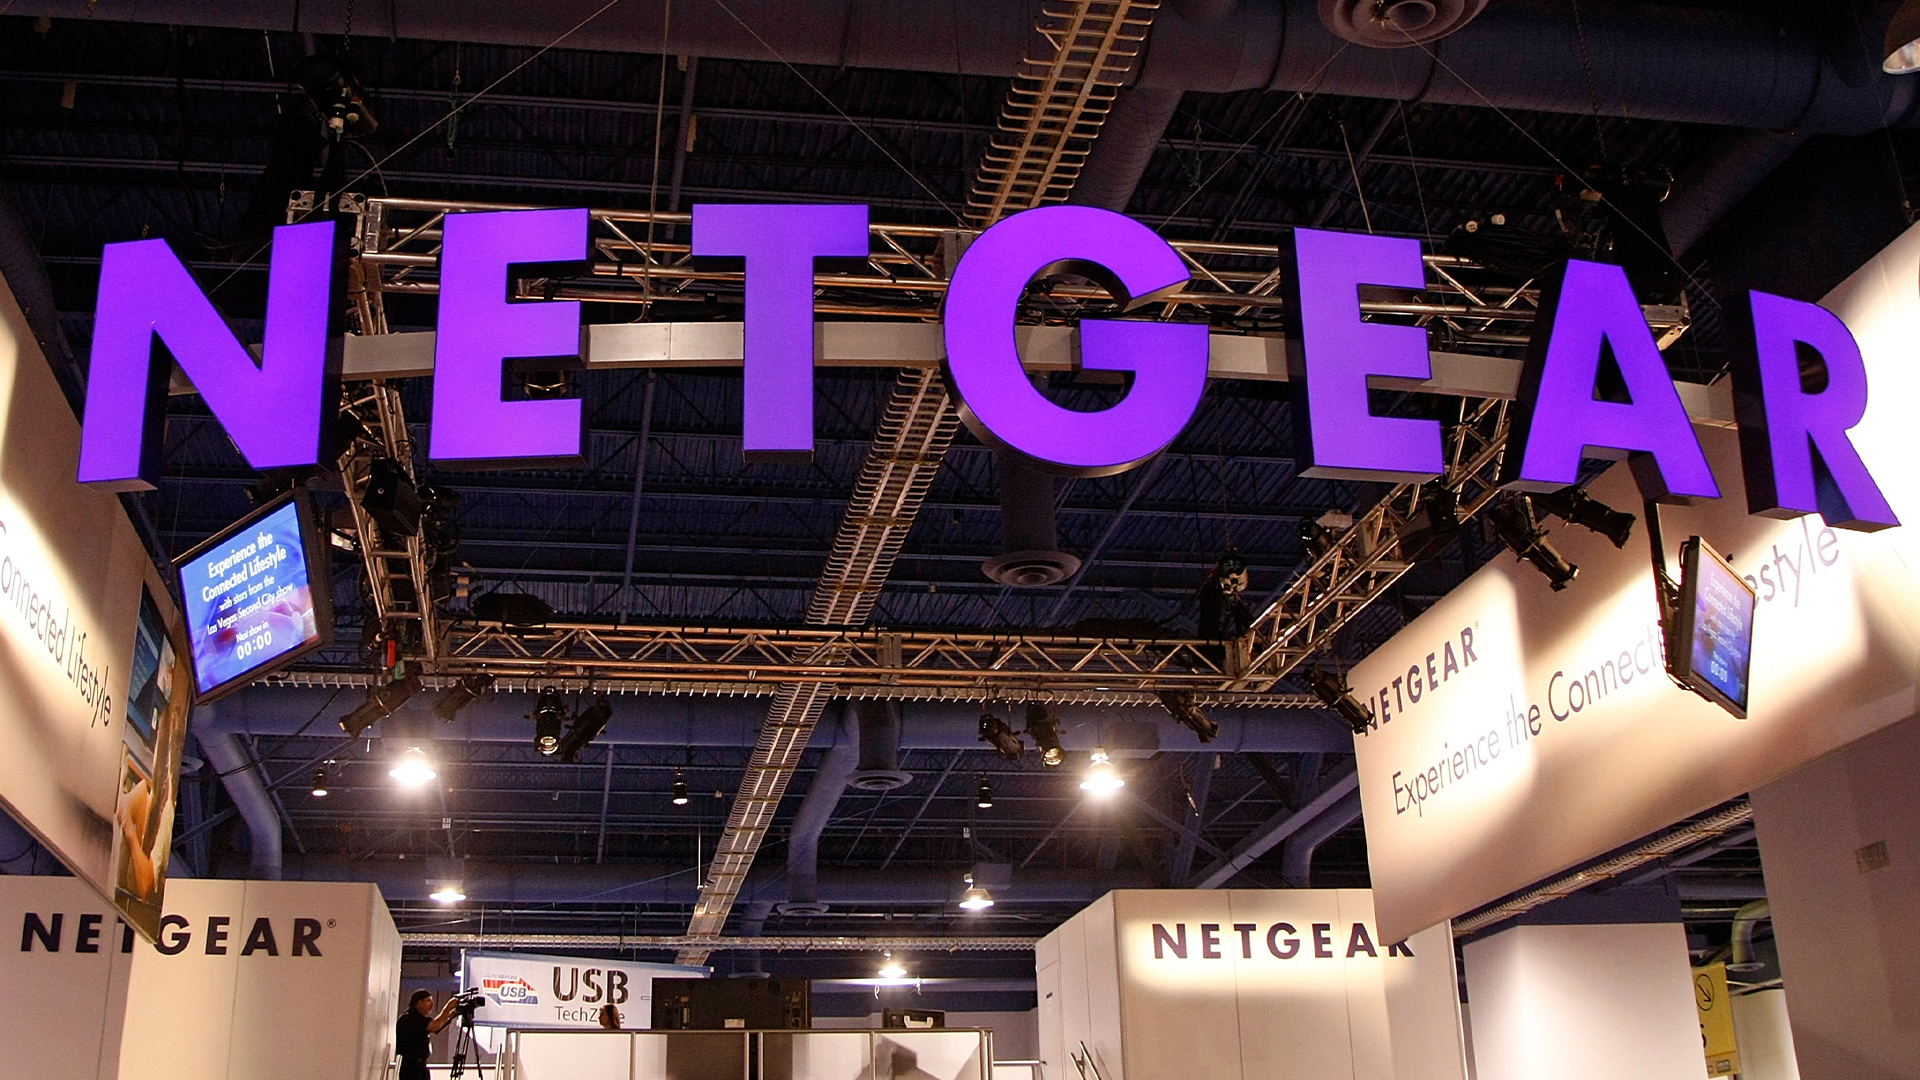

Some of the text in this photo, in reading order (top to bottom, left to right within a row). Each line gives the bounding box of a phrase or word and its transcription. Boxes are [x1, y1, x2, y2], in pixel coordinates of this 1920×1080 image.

[77, 204, 1901, 531] NETGEAR
[202, 544, 287, 602] Connected Lifestyle
[208, 532, 273, 578] Experience the
[207, 583, 294, 636] Las Vegas Second City show
[219, 575, 275, 611] with stars from the
[0, 520, 111, 728] onnected Lifestyle
[236, 631, 248, 643] Next
[248, 625, 262, 638] show
[237, 631, 272, 660] 00:00
[1392, 730, 1500, 818] Experience
[1507, 693, 1542, 748] the
[1548, 624, 1657, 722] Connect
[500, 986, 527, 998] USB
[552, 966, 629, 1004] USB
[554, 1006, 626, 1024] TechZe
